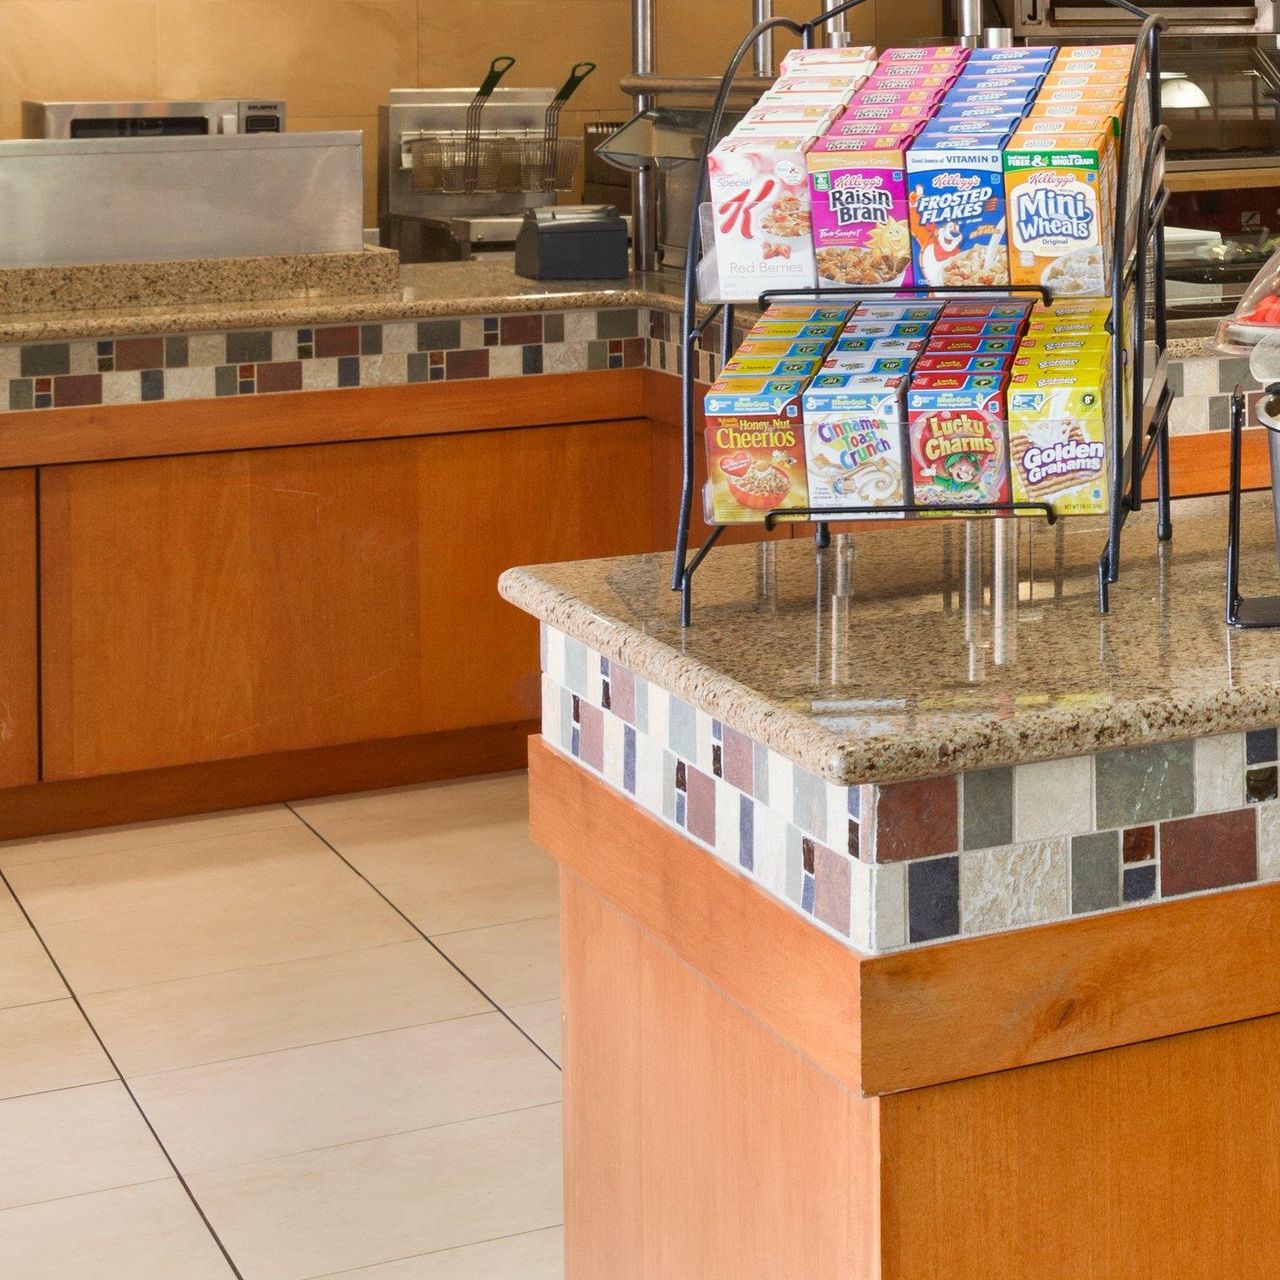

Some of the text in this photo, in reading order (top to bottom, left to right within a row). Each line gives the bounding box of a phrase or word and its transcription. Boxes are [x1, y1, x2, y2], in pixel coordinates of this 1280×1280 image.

[718, 178, 752, 188] Special
[834, 174, 883, 190] Kellogg's
[932, 173, 980, 190] Kellogg's
[1030, 172, 1076, 187] Kellogg's
[719, 180, 775, 239] K
[831, 189, 891, 209] Raisin
[918, 188, 992, 212] FROSTED
[1018, 188, 1089, 222] Mini
[839, 206, 887, 224] Bran
[920, 202, 983, 224] FLAKES
[818, 228, 834, 238] Two
[1019, 216, 1090, 240] Wheats
[730, 262, 804, 273] Red Berries
[740, 420, 771, 432] Honey
[772, 418, 790, 429] Nut
[818, 418, 888, 443] Cinnamon
[930, 414, 985, 439] Lucky
[716, 428, 796, 448] Cheerios
[842, 430, 878, 452] Toast
[926, 437, 996, 460] Charms
[840, 438, 892, 470] Crunch
[1023, 440, 1104, 470] Golden
[1028, 458, 1101, 485] Grahams
